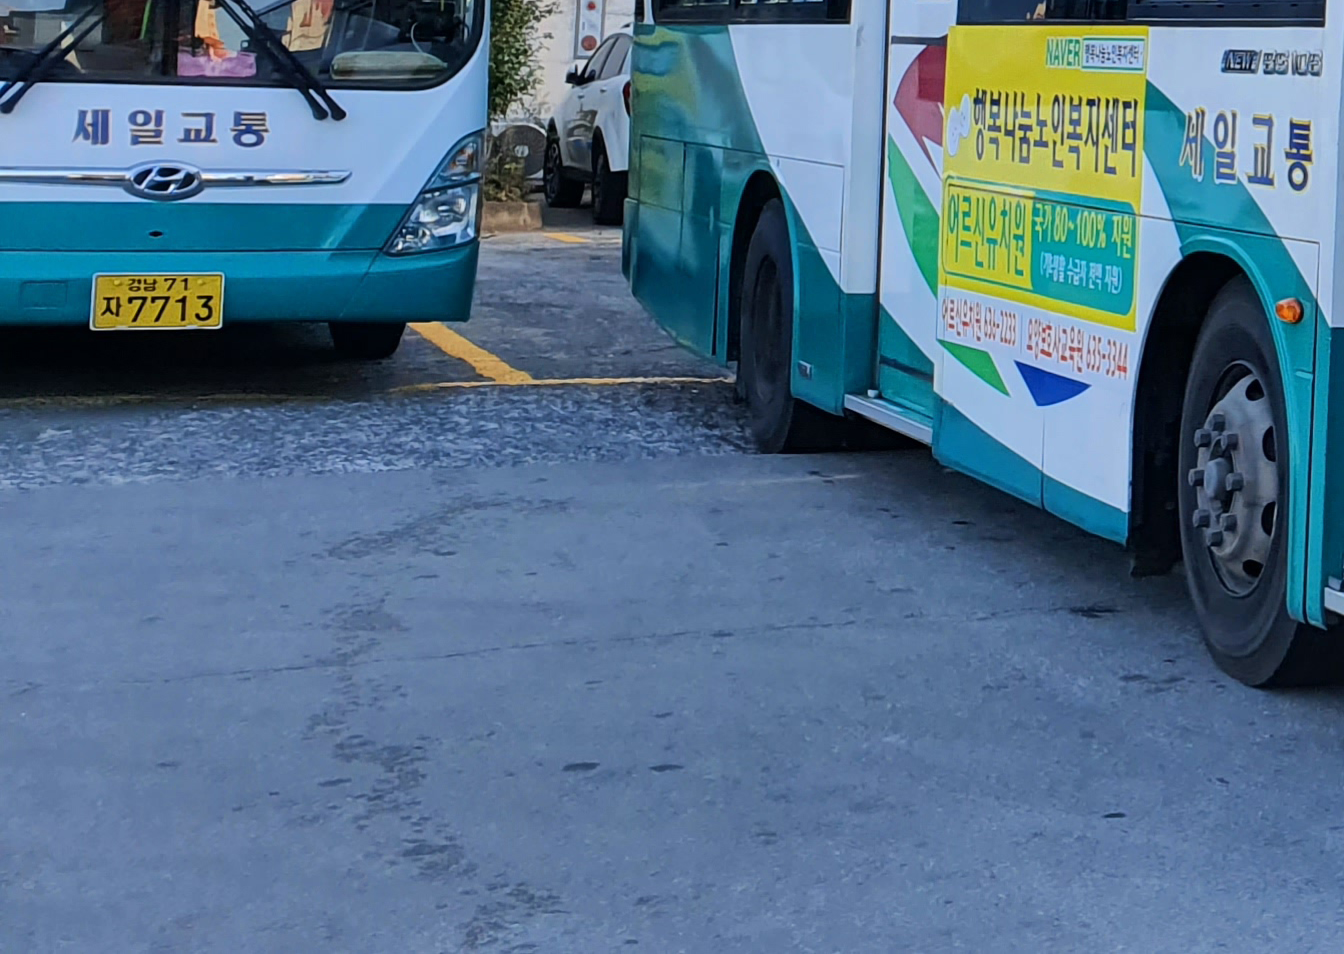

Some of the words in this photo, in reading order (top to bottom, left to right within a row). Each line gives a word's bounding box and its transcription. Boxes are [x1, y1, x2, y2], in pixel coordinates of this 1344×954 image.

[1046, 38, 1080, 67] NAVER
[1226, 50, 1256, 72] NEW
[71, 108, 271, 147] 세일교통
[973, 87, 1138, 178] 행복나눔노인복지센터
[1179, 106, 1314, 192] 세일교통
[949, 193, 1026, 277] 어르신유치원
[1034, 203, 1051, 242] 국가
[1112, 214, 1132, 259] 지원
[128, 278, 158, 292] 경남
[164, 278, 188, 292] 71
[942, 298, 982, 342] 어르신유치원
[984, 306, 1016, 347] 636-2233
[1026, 317, 1084, 373] 요양보호사교육원
